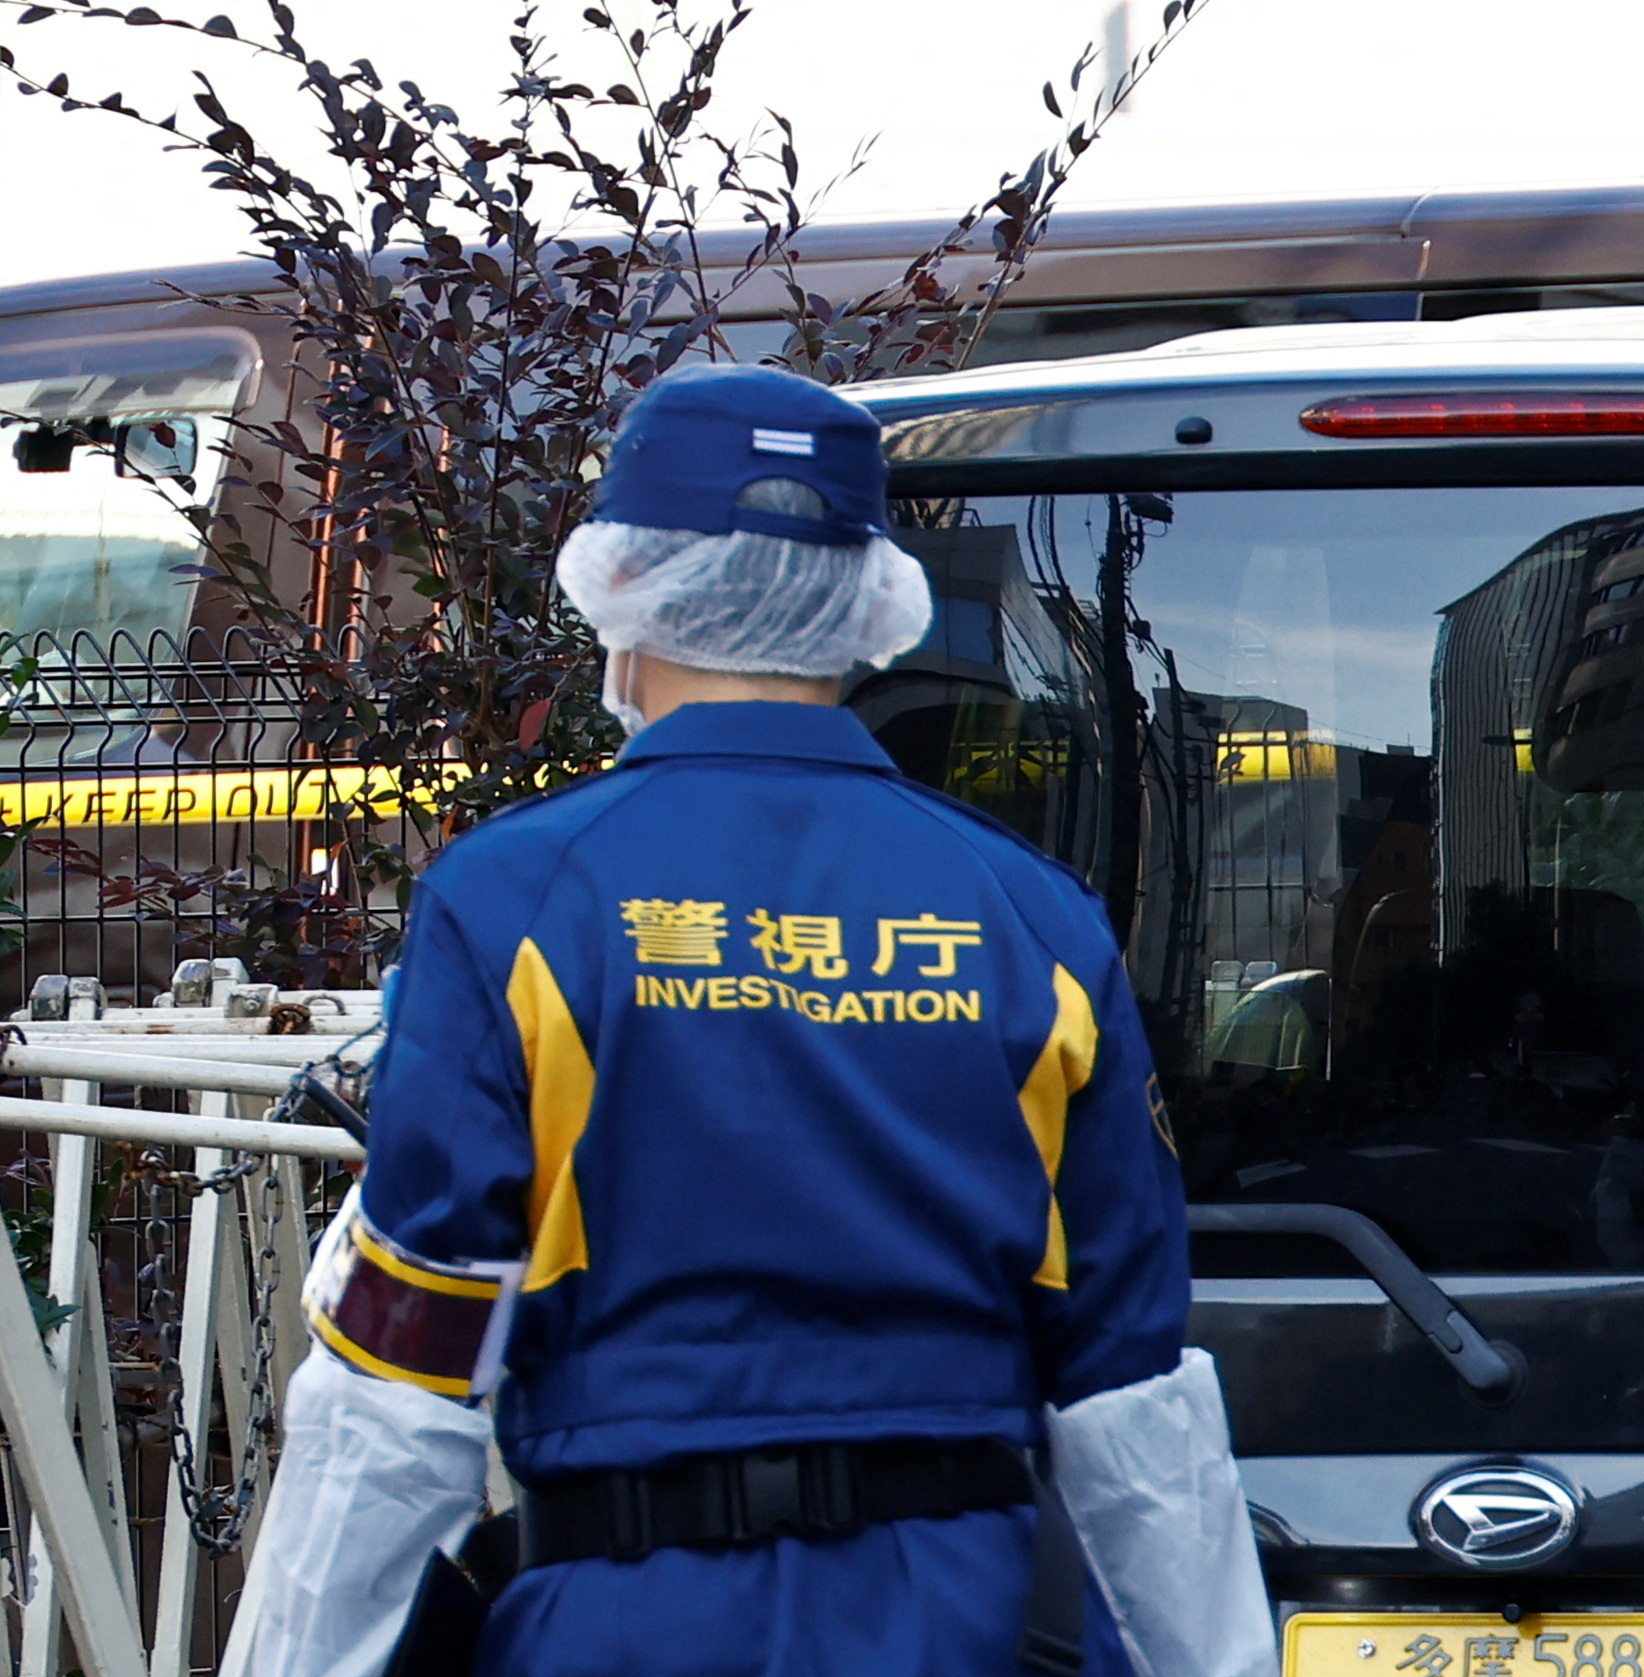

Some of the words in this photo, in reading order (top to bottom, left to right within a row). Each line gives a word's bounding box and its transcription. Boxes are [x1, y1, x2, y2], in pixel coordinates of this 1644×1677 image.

[42, 789, 196, 823] KEEP
[620, 898, 982, 979] 警視庁
[635, 974, 980, 1023] INVESTIGATION
